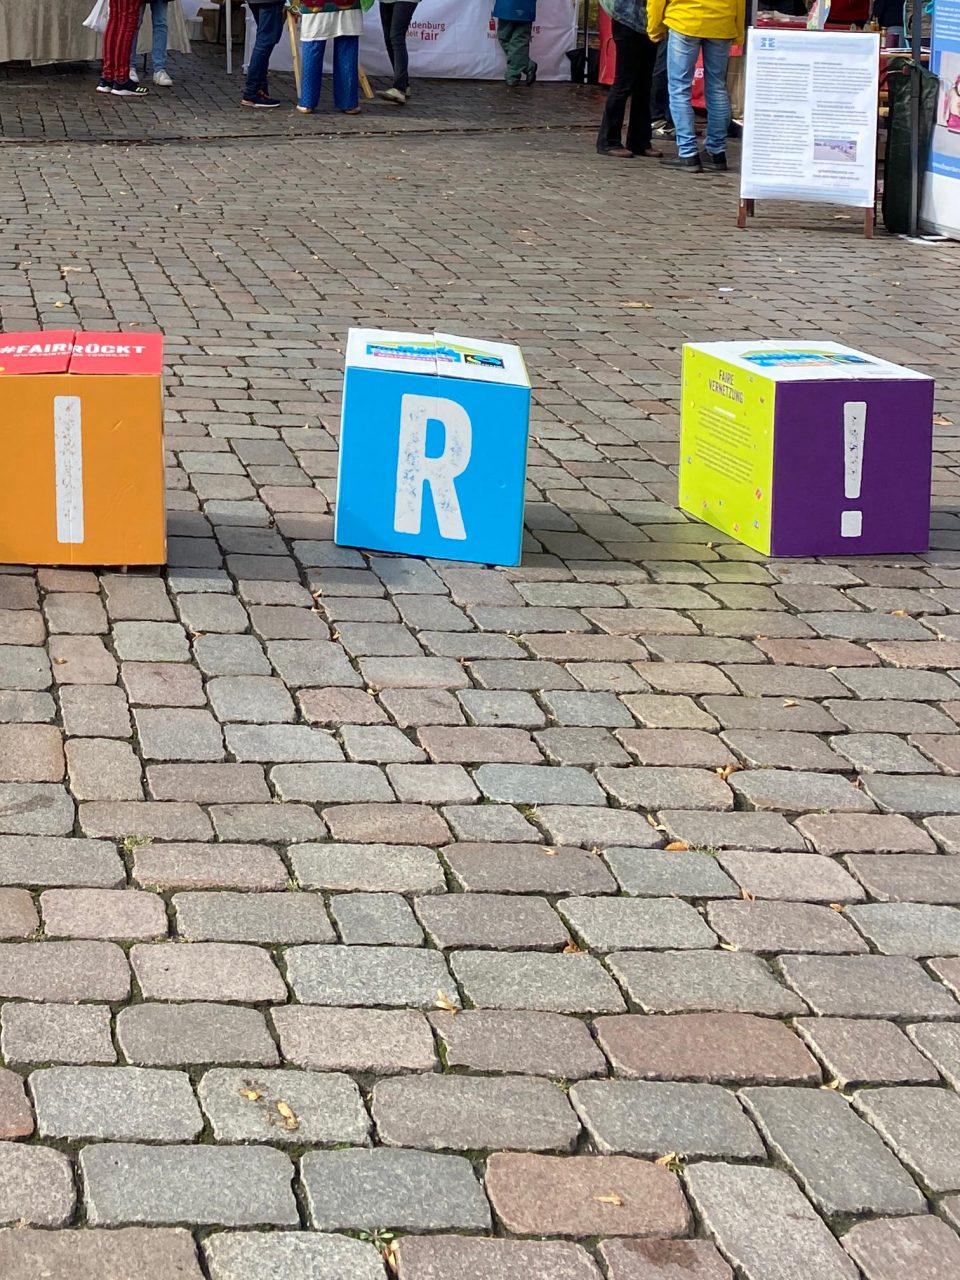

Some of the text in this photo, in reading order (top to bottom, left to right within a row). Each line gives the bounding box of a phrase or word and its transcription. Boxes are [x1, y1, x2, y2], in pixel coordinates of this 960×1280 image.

[409, 20, 446, 32] ldenburg
[421, 29, 439, 41] fair
[54, 395, 84, 544] I
[393, 393, 472, 540] R
[841, 401, 866, 537] !
